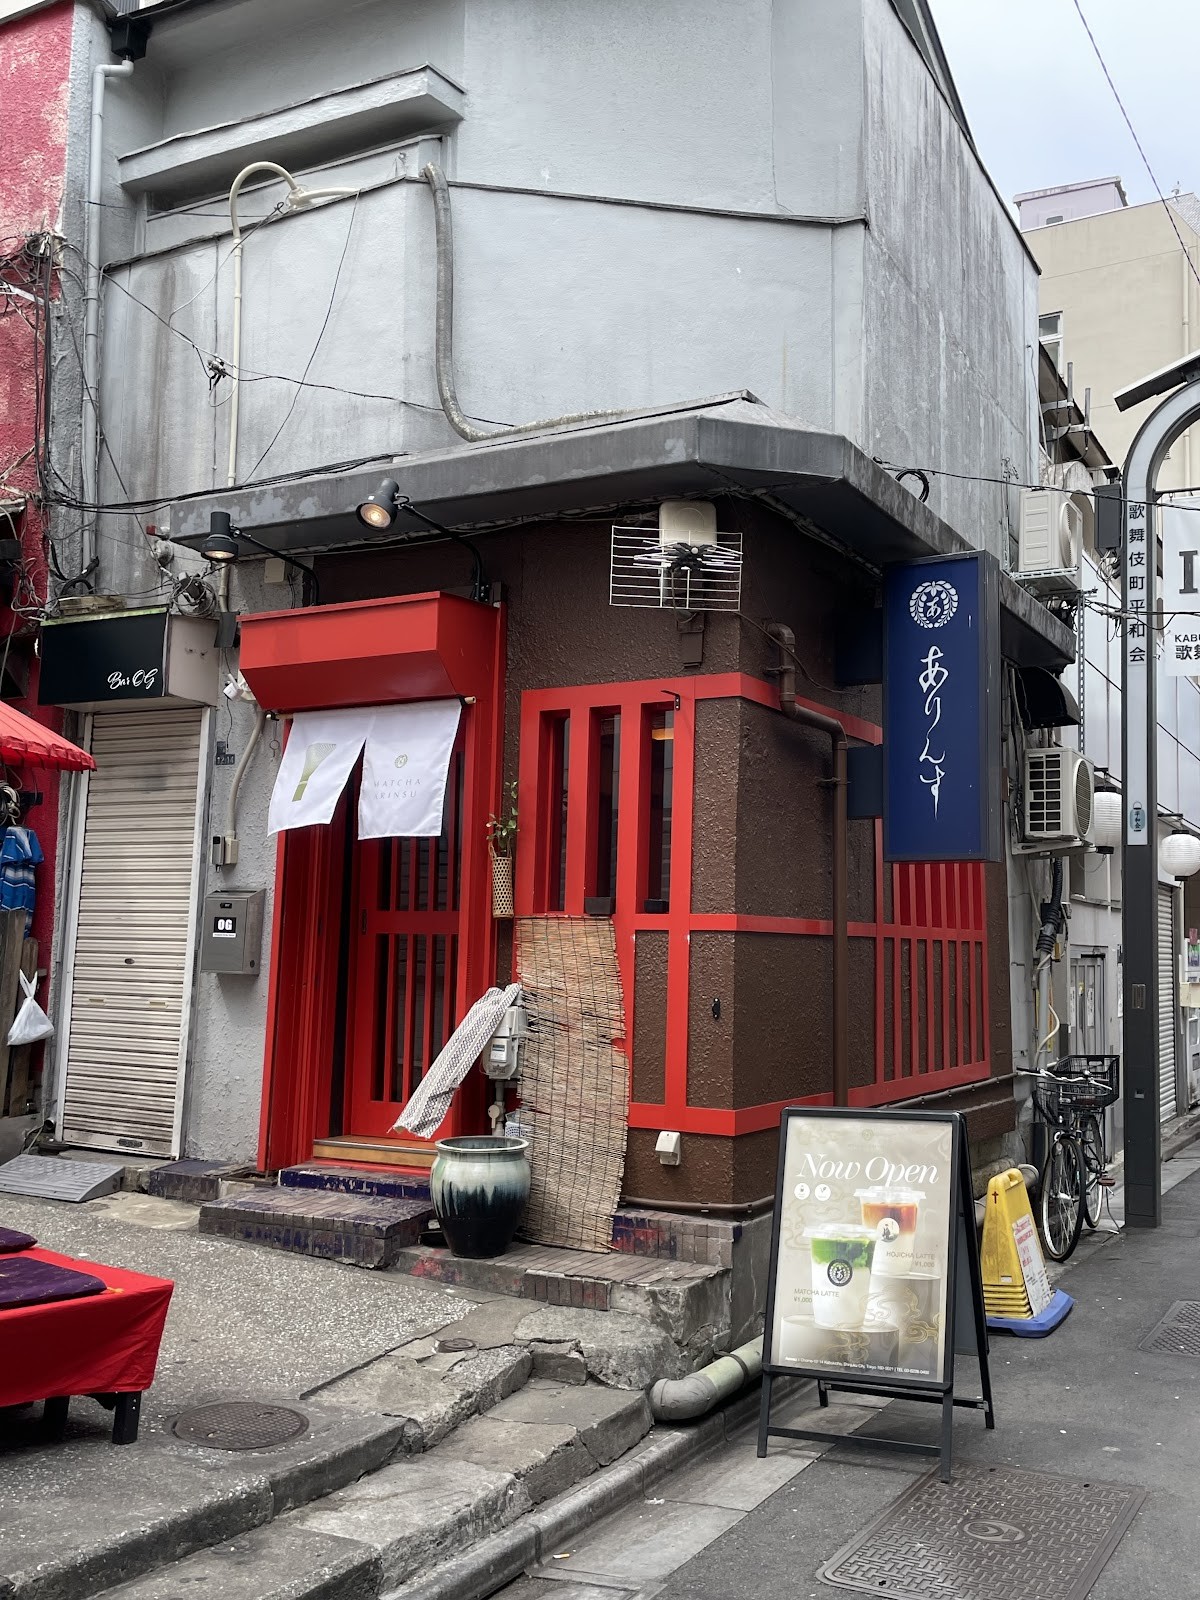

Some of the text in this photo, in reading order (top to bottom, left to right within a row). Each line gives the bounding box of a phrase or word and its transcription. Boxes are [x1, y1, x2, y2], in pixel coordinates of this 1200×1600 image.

[1128, 504, 1146, 663] 歌舞伎町平和会
[926, 597, 942, 620] あ
[1174, 634, 1200, 643] KAB
[919, 645, 949, 821] ありんす
[217, 919, 233, 931] OG
[795, 1153, 940, 1188] Now Open
